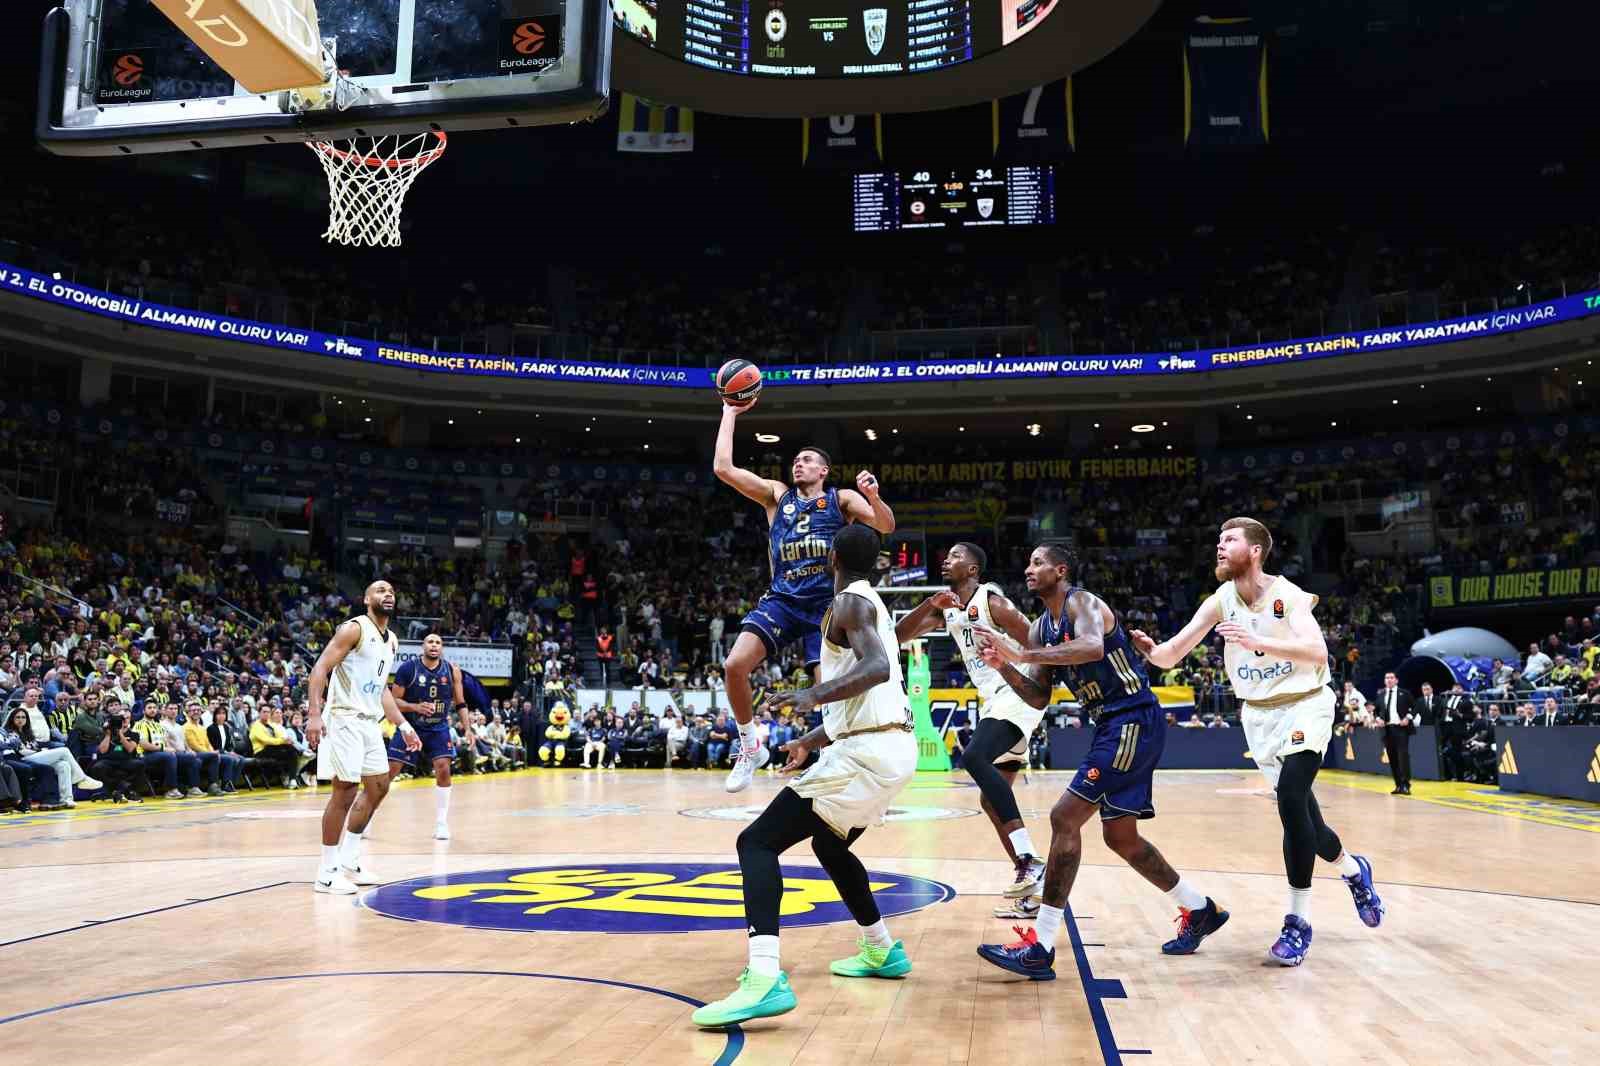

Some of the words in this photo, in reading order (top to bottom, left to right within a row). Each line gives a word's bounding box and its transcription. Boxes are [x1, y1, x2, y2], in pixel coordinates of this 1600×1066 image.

[823, 32, 834, 41] VS
[500, 57, 557, 69] EuroLeague
[843, 65, 862, 73] DUBAI
[863, 63, 903, 73] BASKETBALL
[100, 88, 152, 98] EuroLeague
[913, 171, 930, 182] 40
[976, 169, 992, 180] 34
[10, 273, 24, 287] 2.
[28, 278, 47, 293] EL
[52, 285, 140, 317] OTOMOBİLİ
[141, 308, 217, 331] ALMANIN
[220, 321, 272, 340] OLURU
[276, 330, 309, 346] VAR!
[1212, 343, 1303, 364] FENERBAHÇE
[1306, 336, 1360, 354] TARFİN,
[1363, 331, 1402, 346] FARK
[1405, 318, 1489, 342] YARATMAK
[1491, 313, 1522, 330] İÇİN
[1525, 305, 1556, 322] VAR.
[378, 347, 465, 370] FENERBAHÇE
[468, 358, 518, 373] TARFİN,
[521, 362, 557, 374] FARK
[559, 364, 630, 379] YARATMAK
[632, 367, 658, 381] İÇİN
[660, 370, 688, 382] VAR.
[814, 364, 879, 380] İSTEDİĞİN
[882, 367, 893, 378] 2.
[897, 366, 913, 377] EL
[916, 360, 993, 376] OTOMOBİLİ
[995, 361, 1058, 374] ALMANIN
[1061, 359, 1108, 371] OLURU
[1112, 358, 1143, 369] VAR!
[796, 511, 810, 534] 2
[780, 534, 827, 562] tarfin
[1459, 575, 1490, 602] OUR
[1493, 571, 1545, 600] HOUSE
[1548, 568, 1582, 597] OUR
[962, 628, 975, 647] 21
[377, 659, 385, 678] 0
[1238, 661, 1293, 681] dnata
[429, 685, 437, 698] 8
